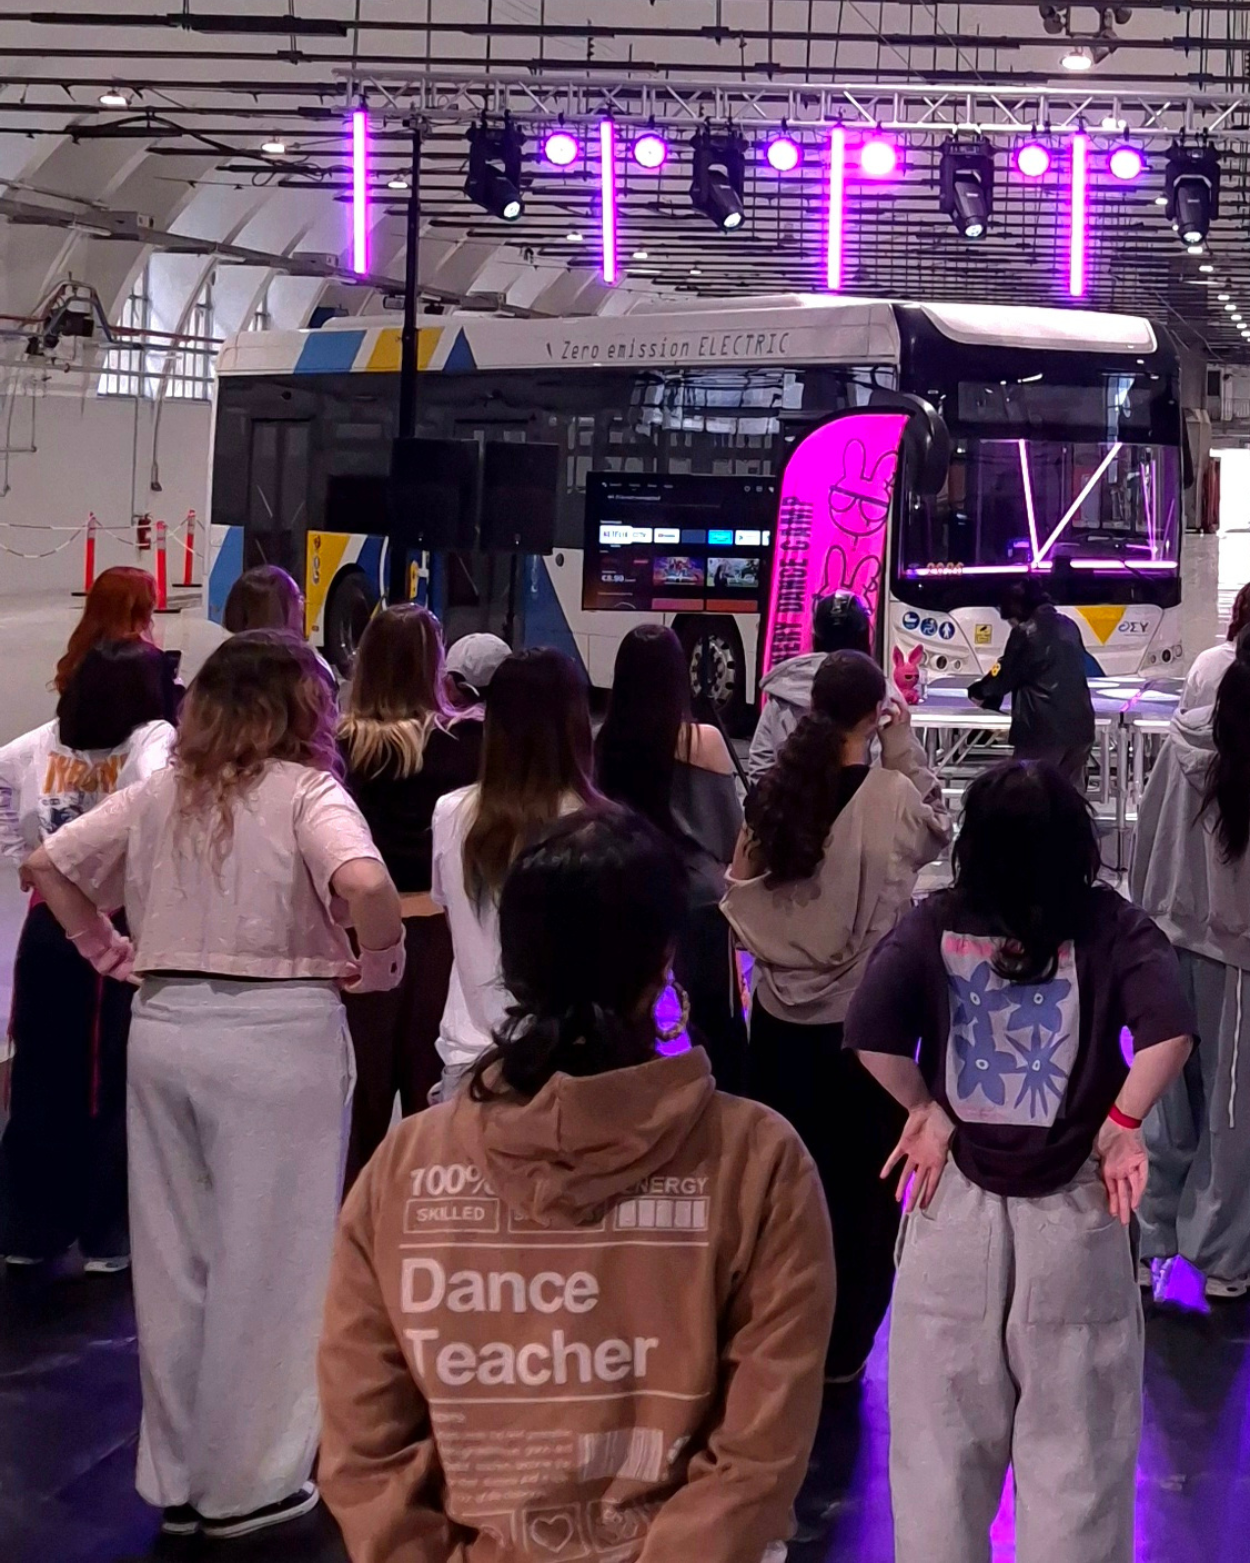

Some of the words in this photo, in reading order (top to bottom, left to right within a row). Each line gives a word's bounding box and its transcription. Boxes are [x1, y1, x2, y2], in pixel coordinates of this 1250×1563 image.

[562, 341, 599, 360] Zero
[607, 337, 689, 359] emission
[698, 333, 790, 357] ELECTRIC
[779, 496, 815, 551] CAMP
[777, 558, 809, 612] DANCE
[410, 1164, 496, 1197] 100%
[625, 1176, 709, 1195] NERGY
[416, 1206, 486, 1223] SKILLED
[401, 1257, 600, 1315] Dance
[403, 1328, 659, 1387] Teacher
